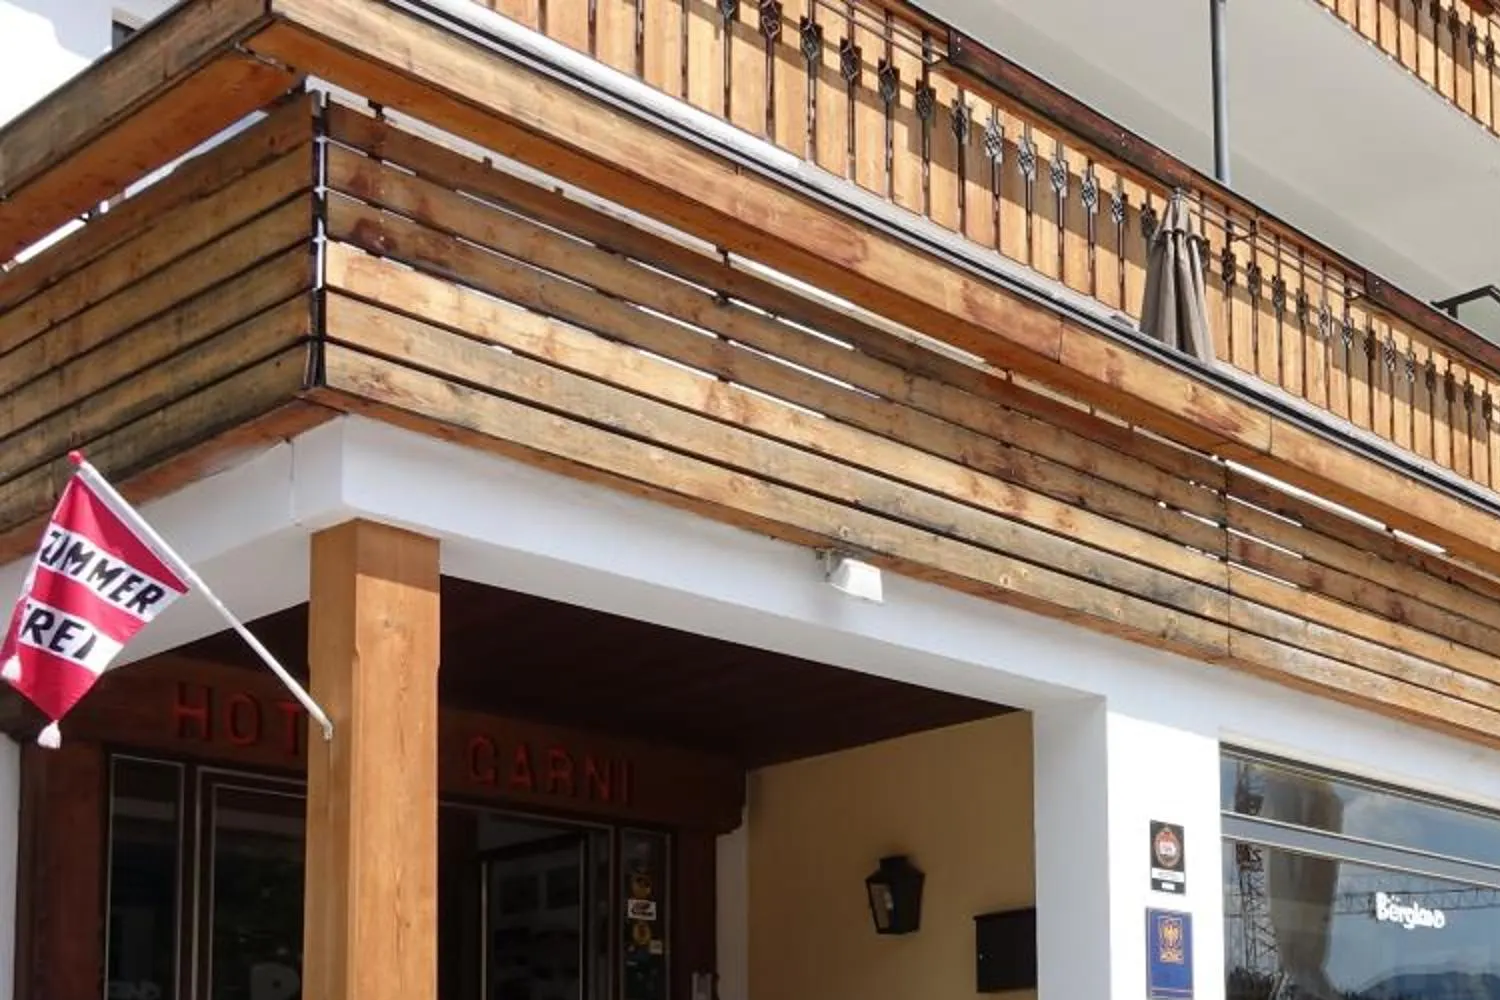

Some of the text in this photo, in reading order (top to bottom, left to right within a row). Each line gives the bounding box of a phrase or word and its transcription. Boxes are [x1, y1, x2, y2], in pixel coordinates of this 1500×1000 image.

[22, 603, 97, 661] REI
[172, 681, 636, 808] HOT GARNI
